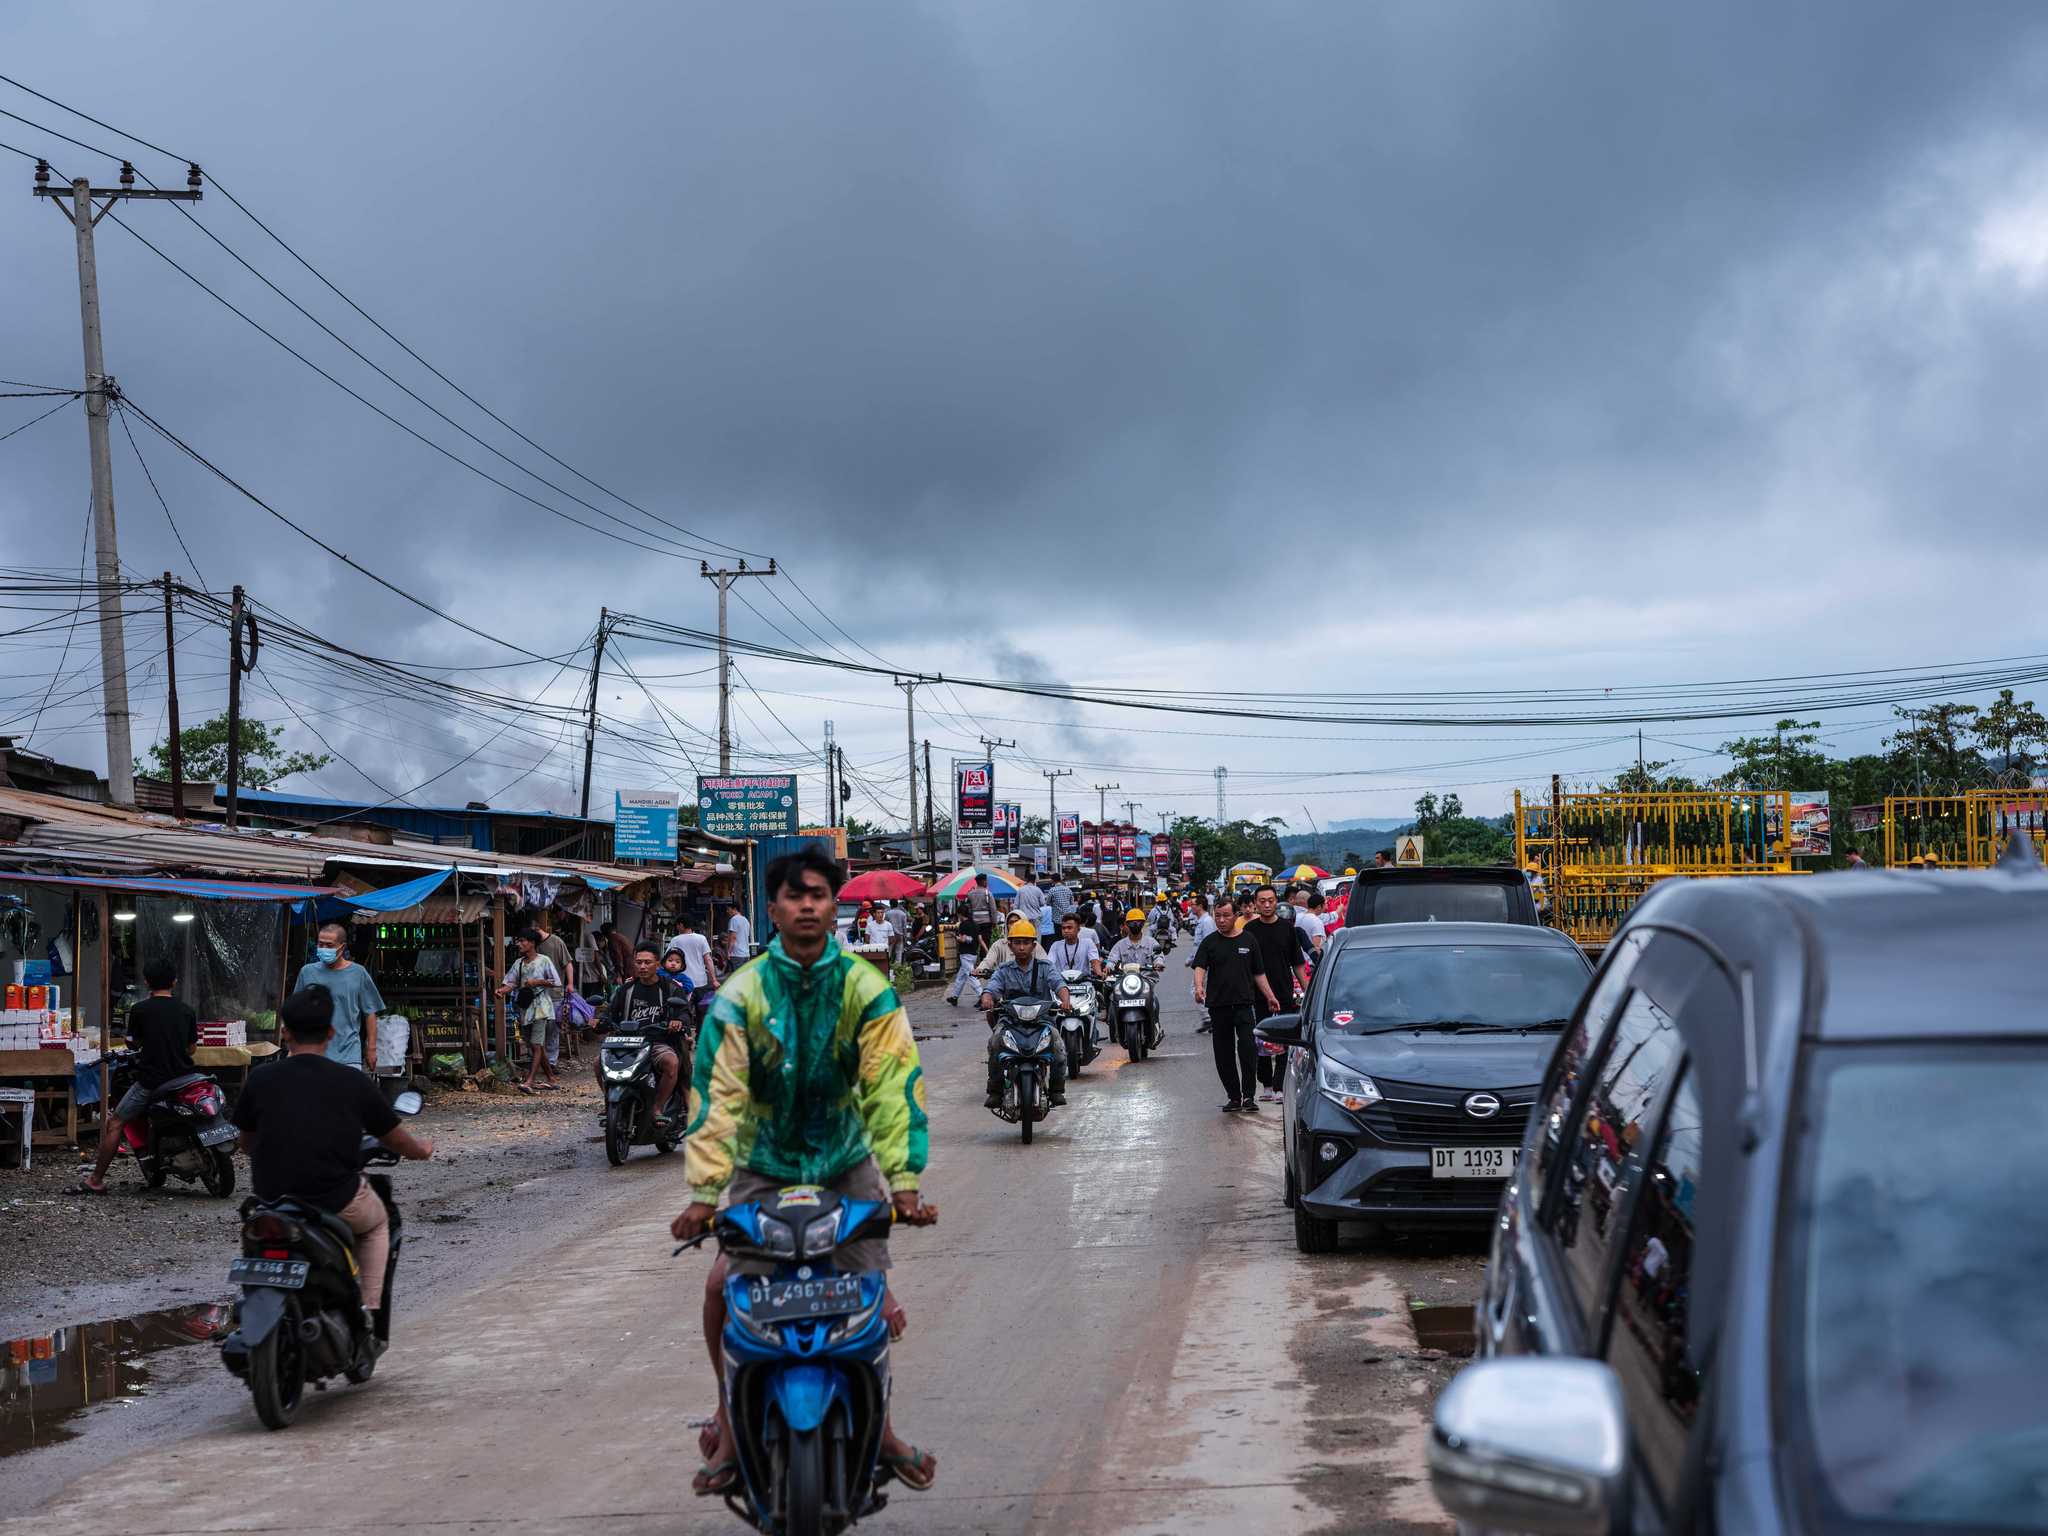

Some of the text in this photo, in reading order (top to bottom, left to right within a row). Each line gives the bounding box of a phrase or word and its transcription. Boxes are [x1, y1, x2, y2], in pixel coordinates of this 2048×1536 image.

[1435, 1150, 1455, 1167] DT
[1464, 1150, 1503, 1167] 1193
[752, 1287, 771, 1303] DT
